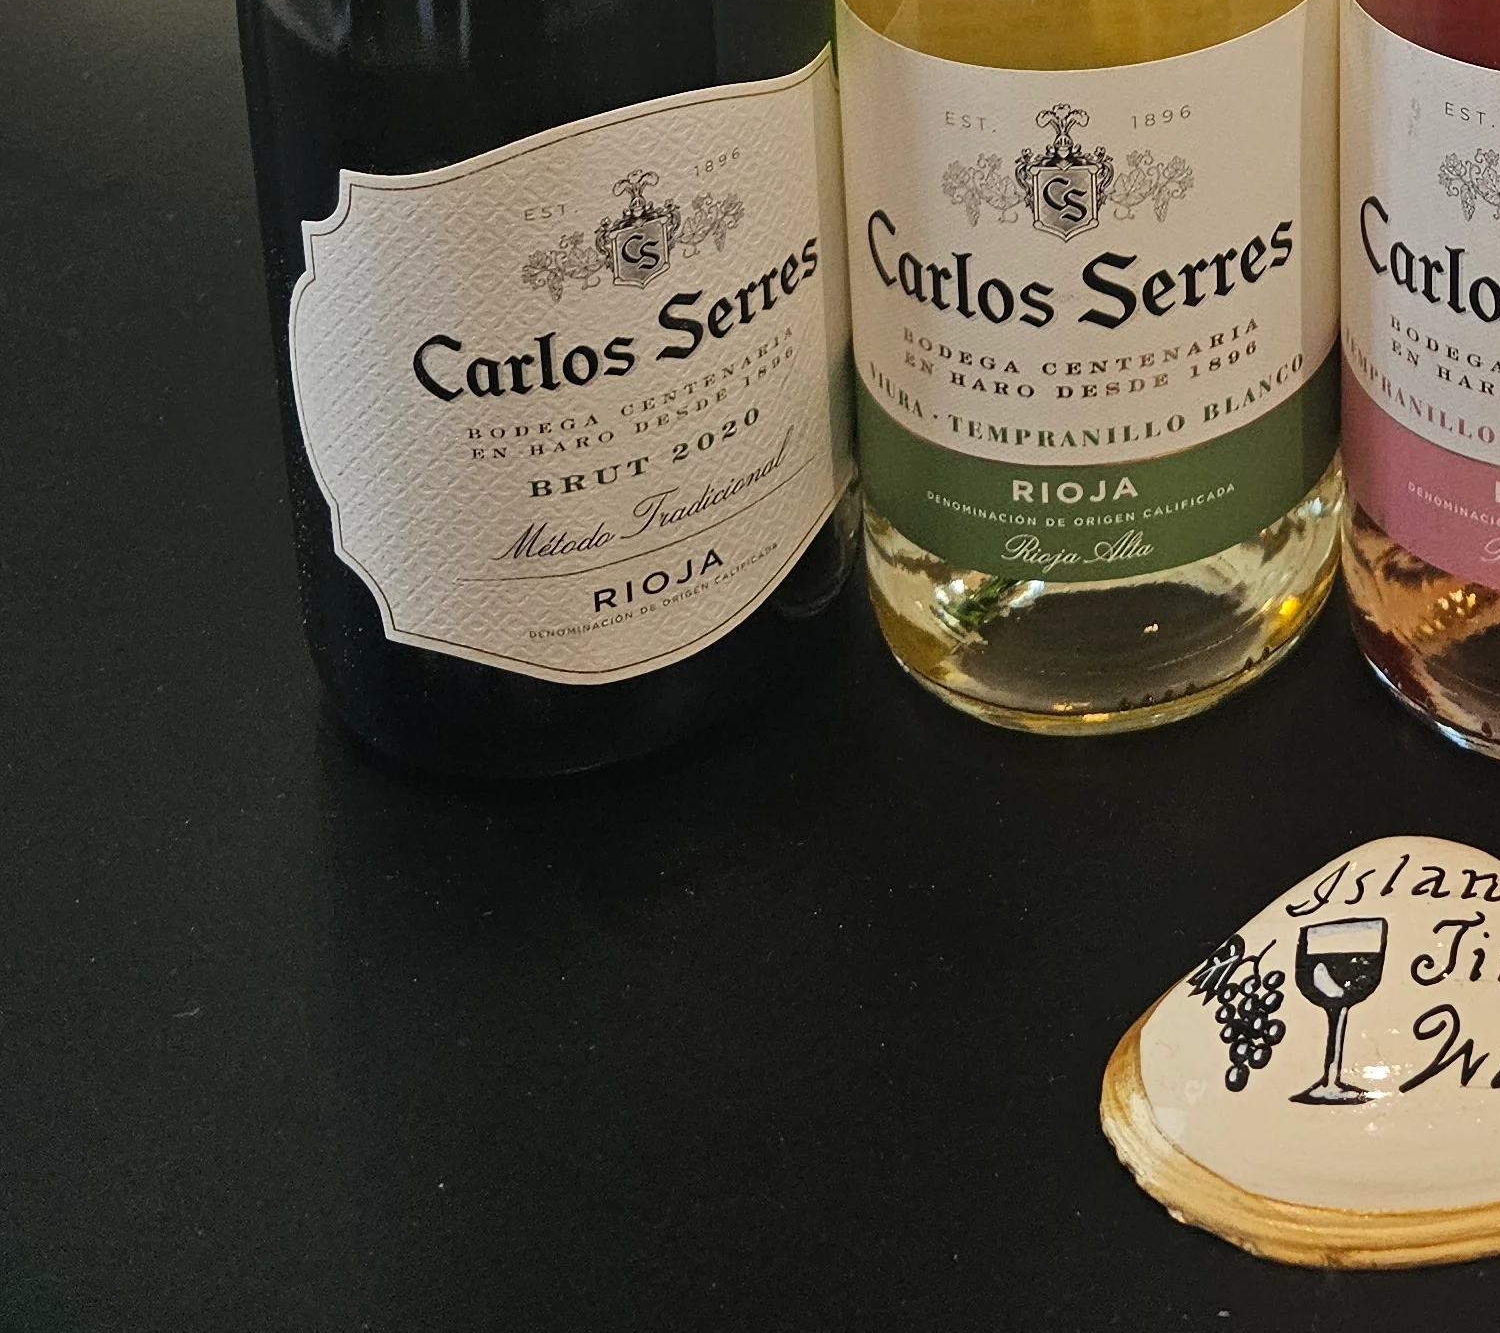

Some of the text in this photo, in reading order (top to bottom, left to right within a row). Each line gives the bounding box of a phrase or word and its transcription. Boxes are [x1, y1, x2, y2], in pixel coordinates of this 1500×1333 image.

[1130, 104, 1193, 130] 1896
[693, 147, 741, 177] 1896
[867, 208, 1293, 330] Carlos Serres
[413, 236, 820, 403] Carlos Serres
[903, 317, 1259, 376] BODEGA CENTENARIA
[467, 327, 793, 439] BODEGA CENTENARIA
[904, 340, 1257, 399] EN HARO DESDE 1896
[1391, 337, 1420, 368] EN
[471, 345, 794, 460] EN HARO DESDE 1896
[869, 352, 1304, 448] VIURA TEMPRANILLO BLANCO
[528, 407, 760, 498] BRUT 2020
[491, 424, 794, 561] Método Tradicional
[926, 482, 1236, 528] DENOMINACIÓN DE ORIGEN CALIFICADA
[1011, 476, 1139, 504] RIOJA
[593, 548, 724, 613] RIOJA
[640, 602, 656, 615] DE
[662, 582, 709, 607] ORIGEN
[714, 542, 778, 585] CALIFICADA
[1000, 529, 1155, 574] Rioja Alta
